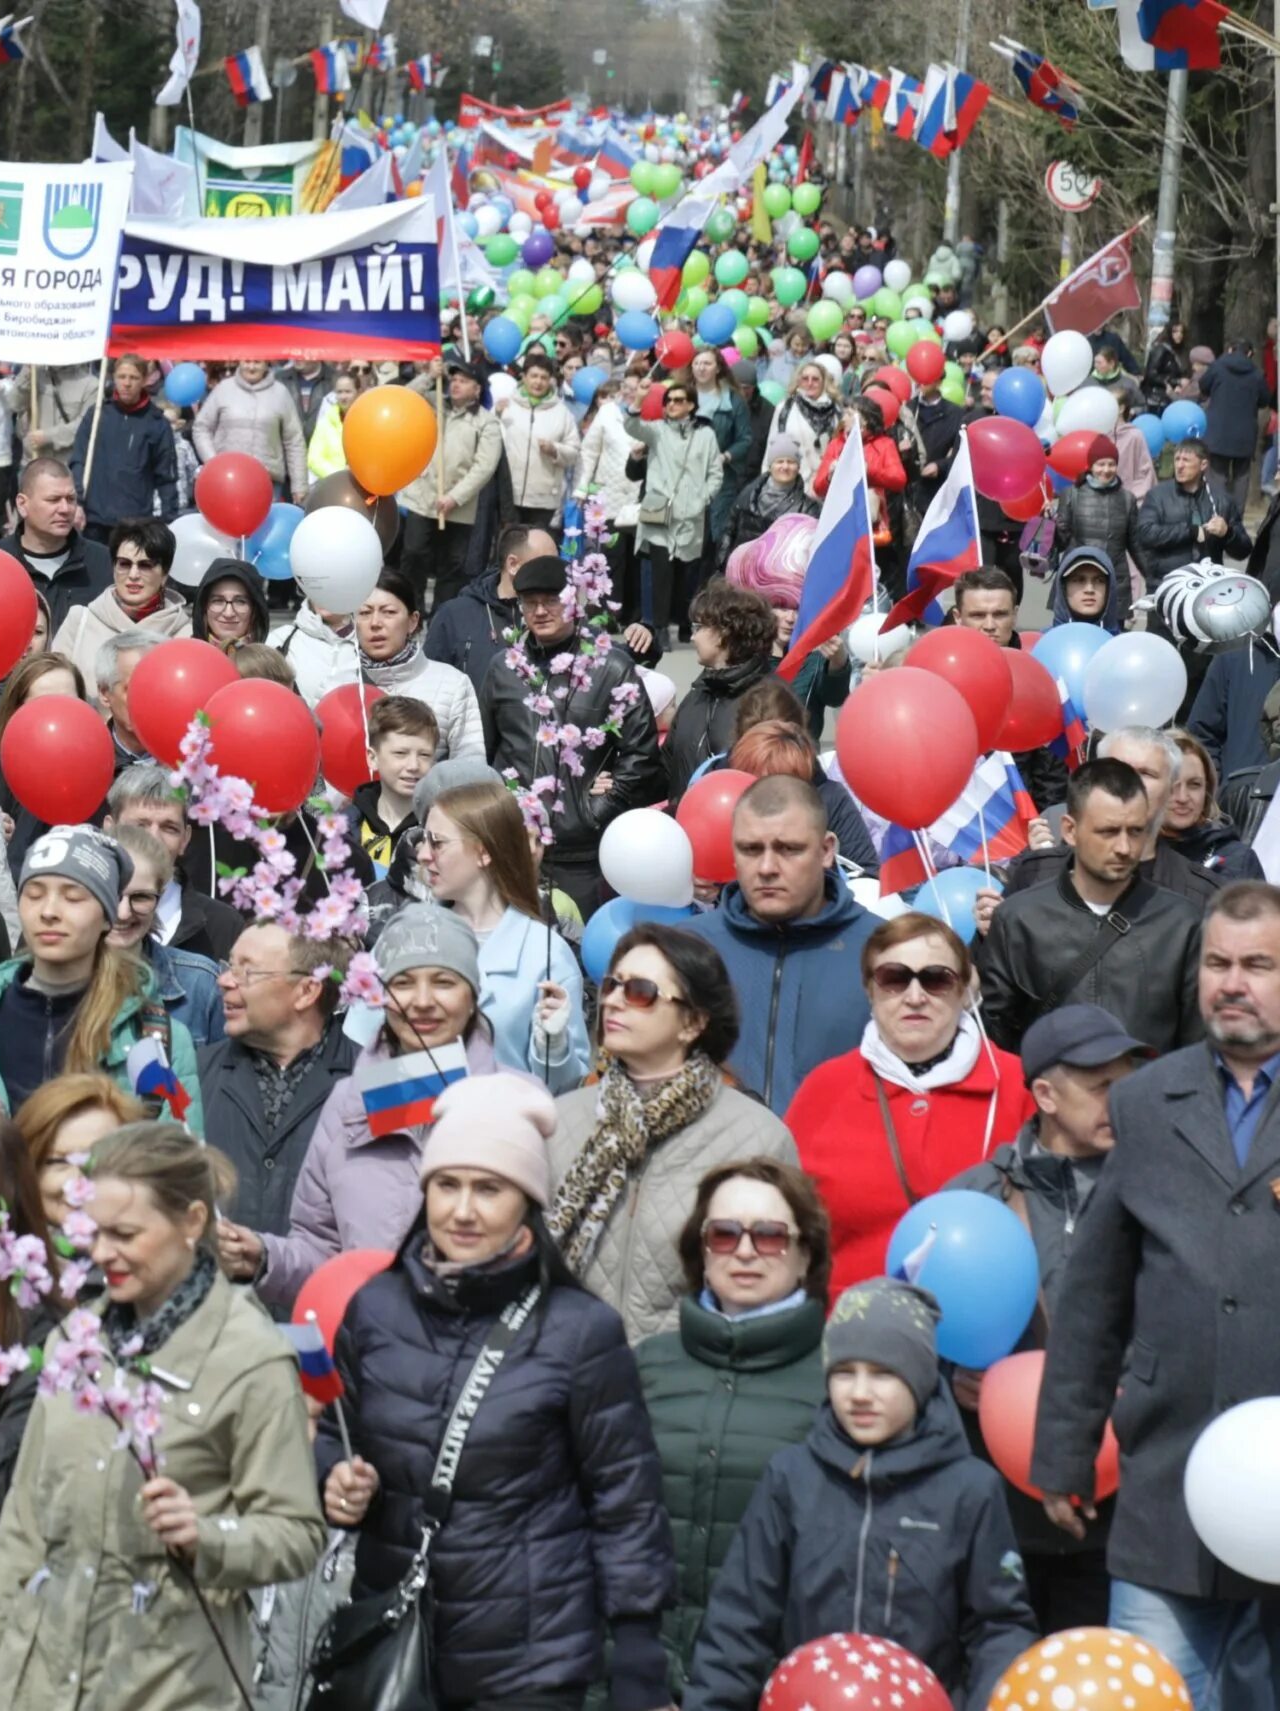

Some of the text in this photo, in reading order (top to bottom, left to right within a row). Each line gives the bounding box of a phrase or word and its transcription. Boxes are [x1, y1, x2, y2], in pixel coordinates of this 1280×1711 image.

[24, 268, 102, 293] ГОРОДА
[114, 242, 425, 322] РУД! МАЙ!
[29, 829, 74, 869] 5
